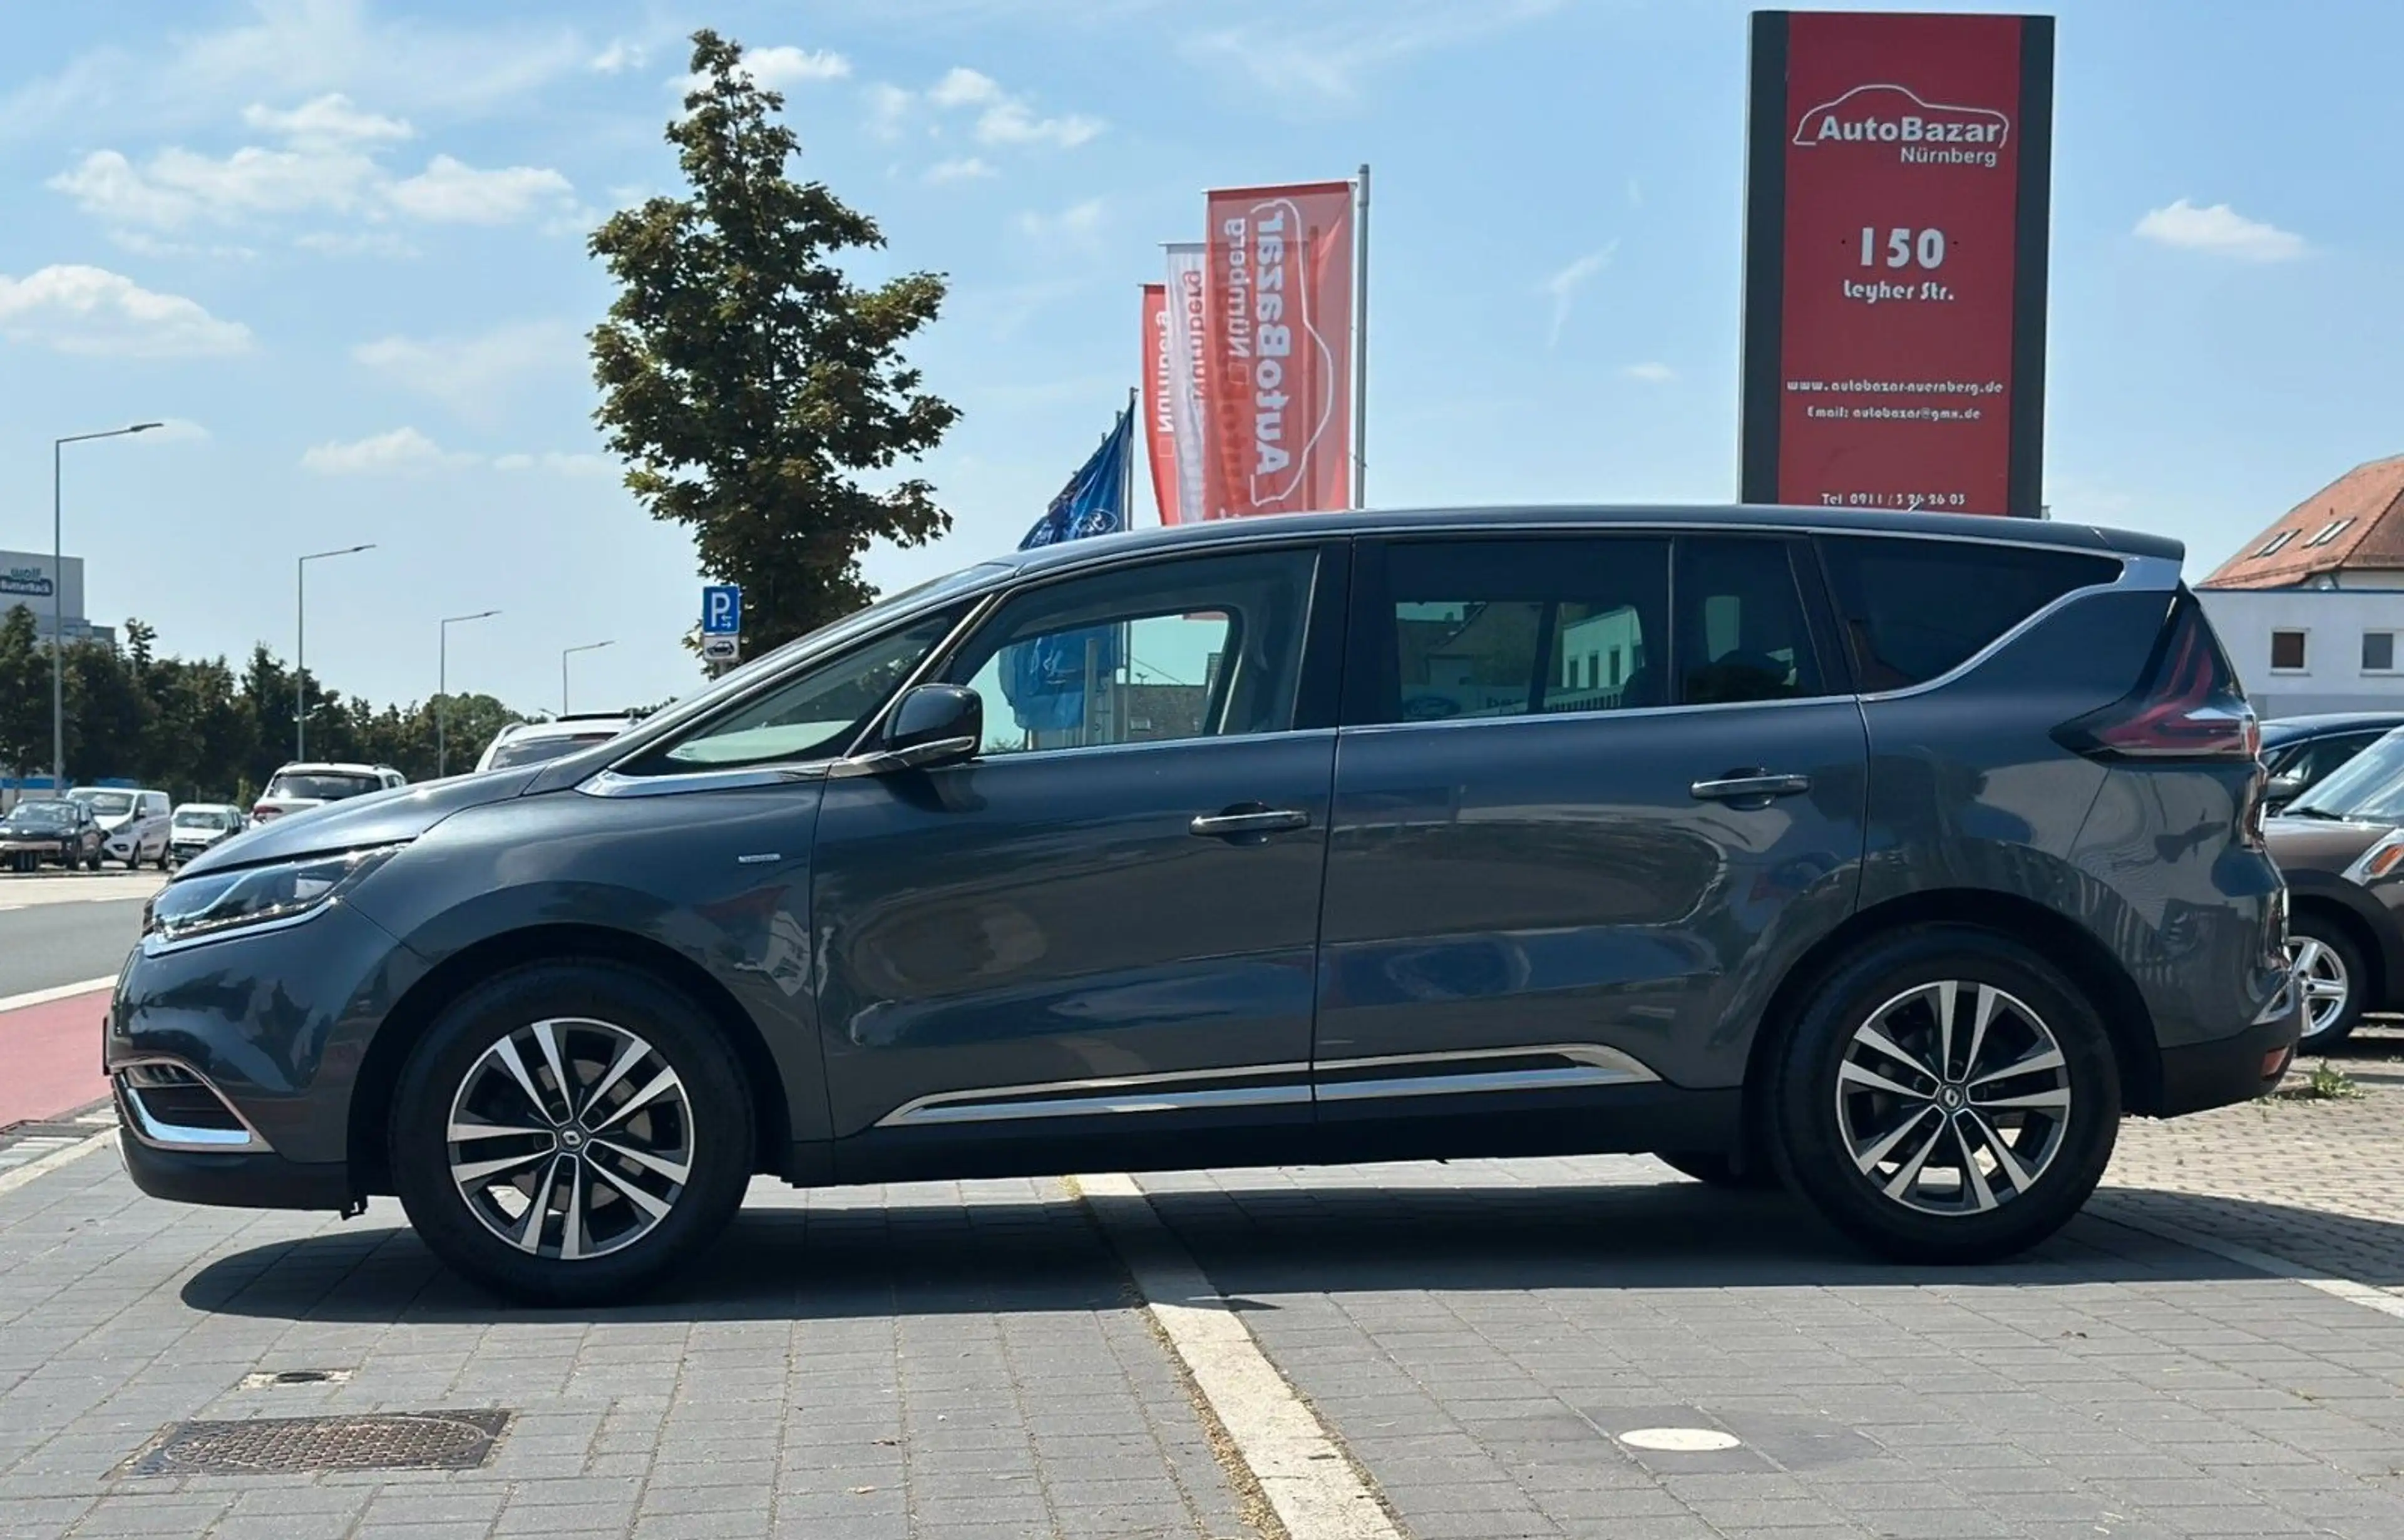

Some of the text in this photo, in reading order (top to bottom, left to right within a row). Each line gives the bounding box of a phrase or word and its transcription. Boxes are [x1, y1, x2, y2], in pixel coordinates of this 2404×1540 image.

[1818, 116, 2000, 142] AutoBazar
[1900, 146, 1996, 168] Nürnberg
[1861, 227, 1944, 269] 150
[1844, 279, 1954, 304] Leyher Str.
[1807, 406, 1849, 418] Email:
[1821, 493, 1842, 505] Tel
[711, 592, 731, 628] P
